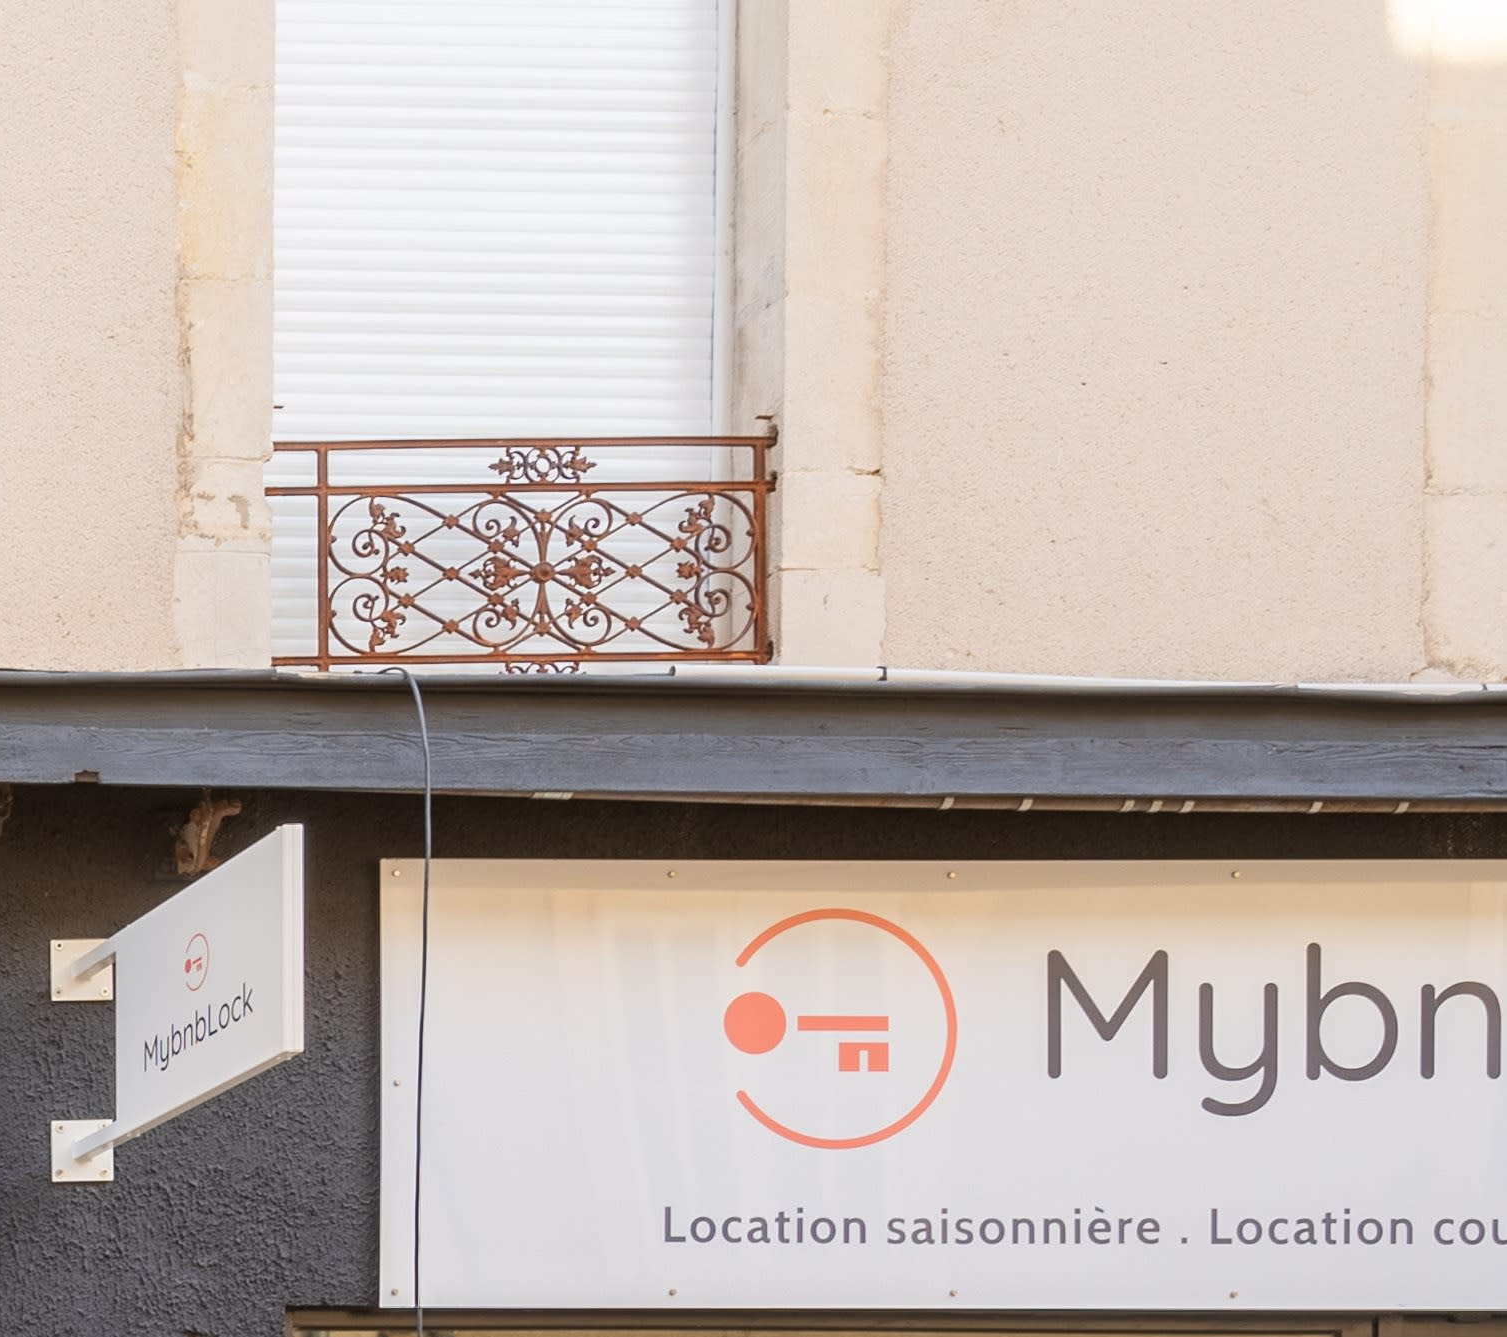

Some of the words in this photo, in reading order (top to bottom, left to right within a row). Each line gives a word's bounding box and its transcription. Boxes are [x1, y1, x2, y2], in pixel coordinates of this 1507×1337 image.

[1046, 942, 1502, 1117] Mybn
[663, 1205, 867, 1244] Location
[886, 1205, 1162, 1246] saisonnière
[1210, 1207, 1414, 1246] Location
